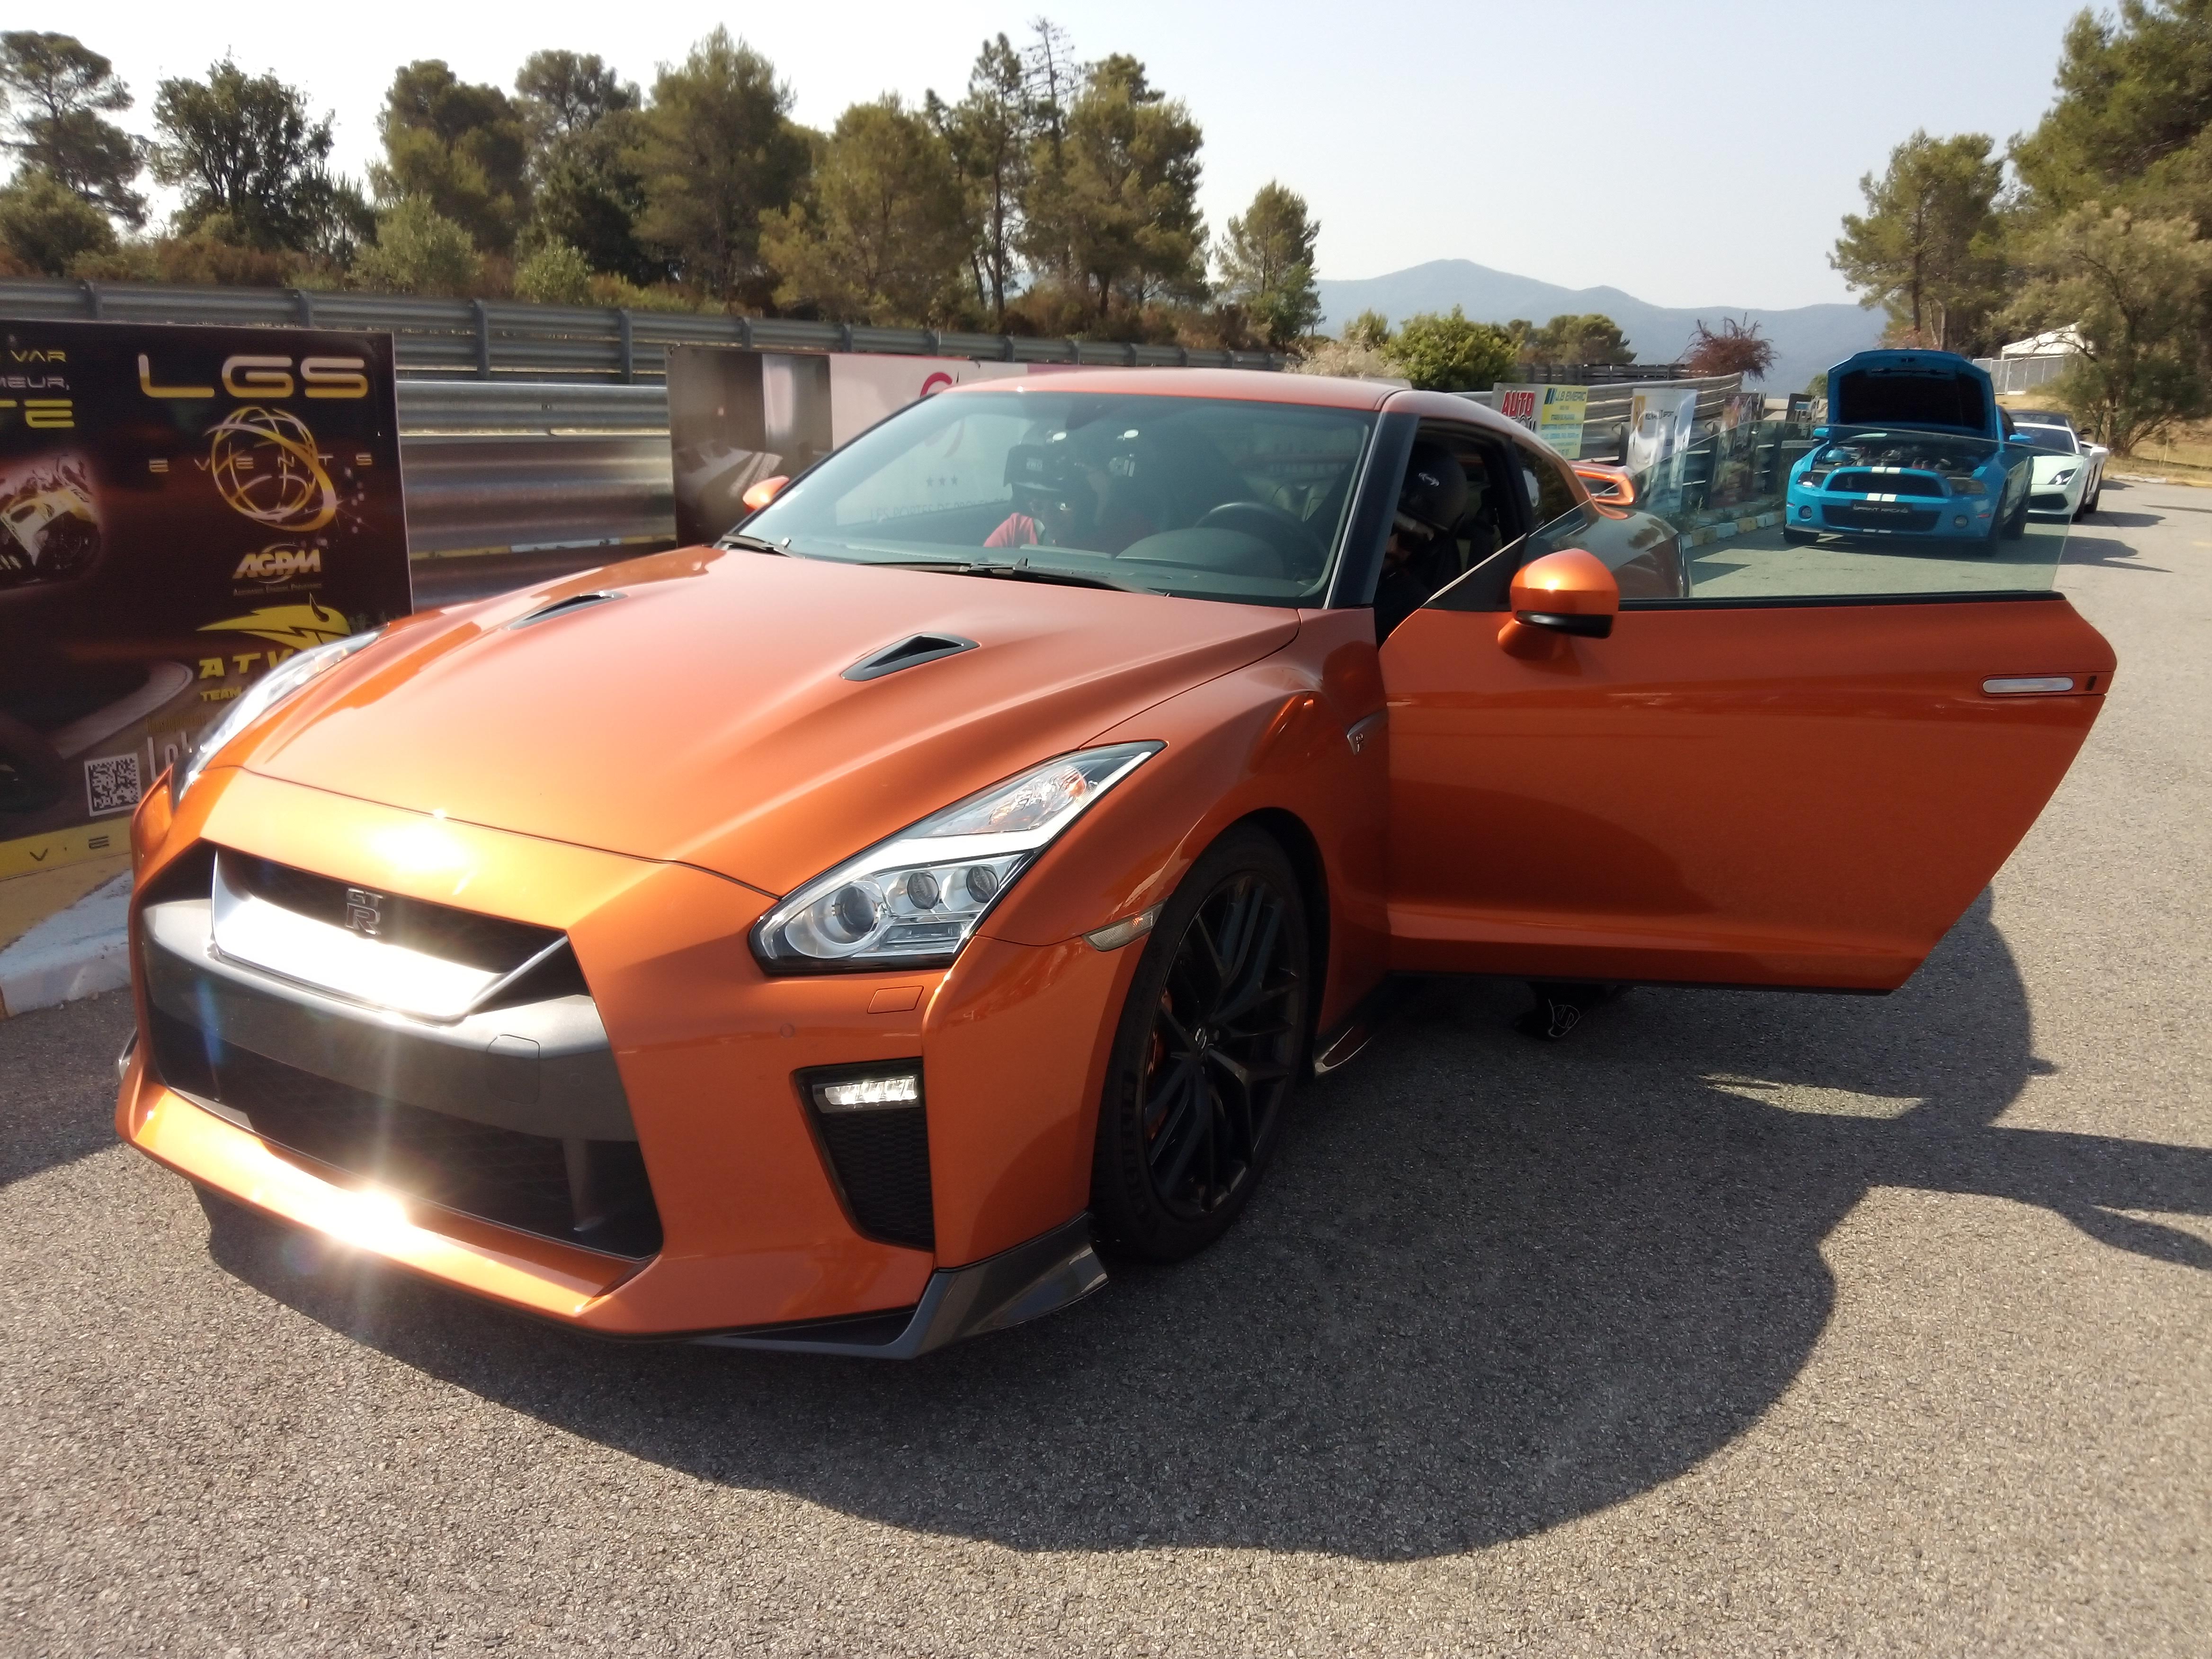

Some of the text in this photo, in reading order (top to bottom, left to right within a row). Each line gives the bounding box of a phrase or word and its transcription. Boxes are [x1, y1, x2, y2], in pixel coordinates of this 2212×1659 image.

[10, 349, 67, 363] VAR
[139, 354, 368, 398] LGS
[1500, 391, 1535, 419] AUTO
[149, 453, 373, 473] EVENTS
